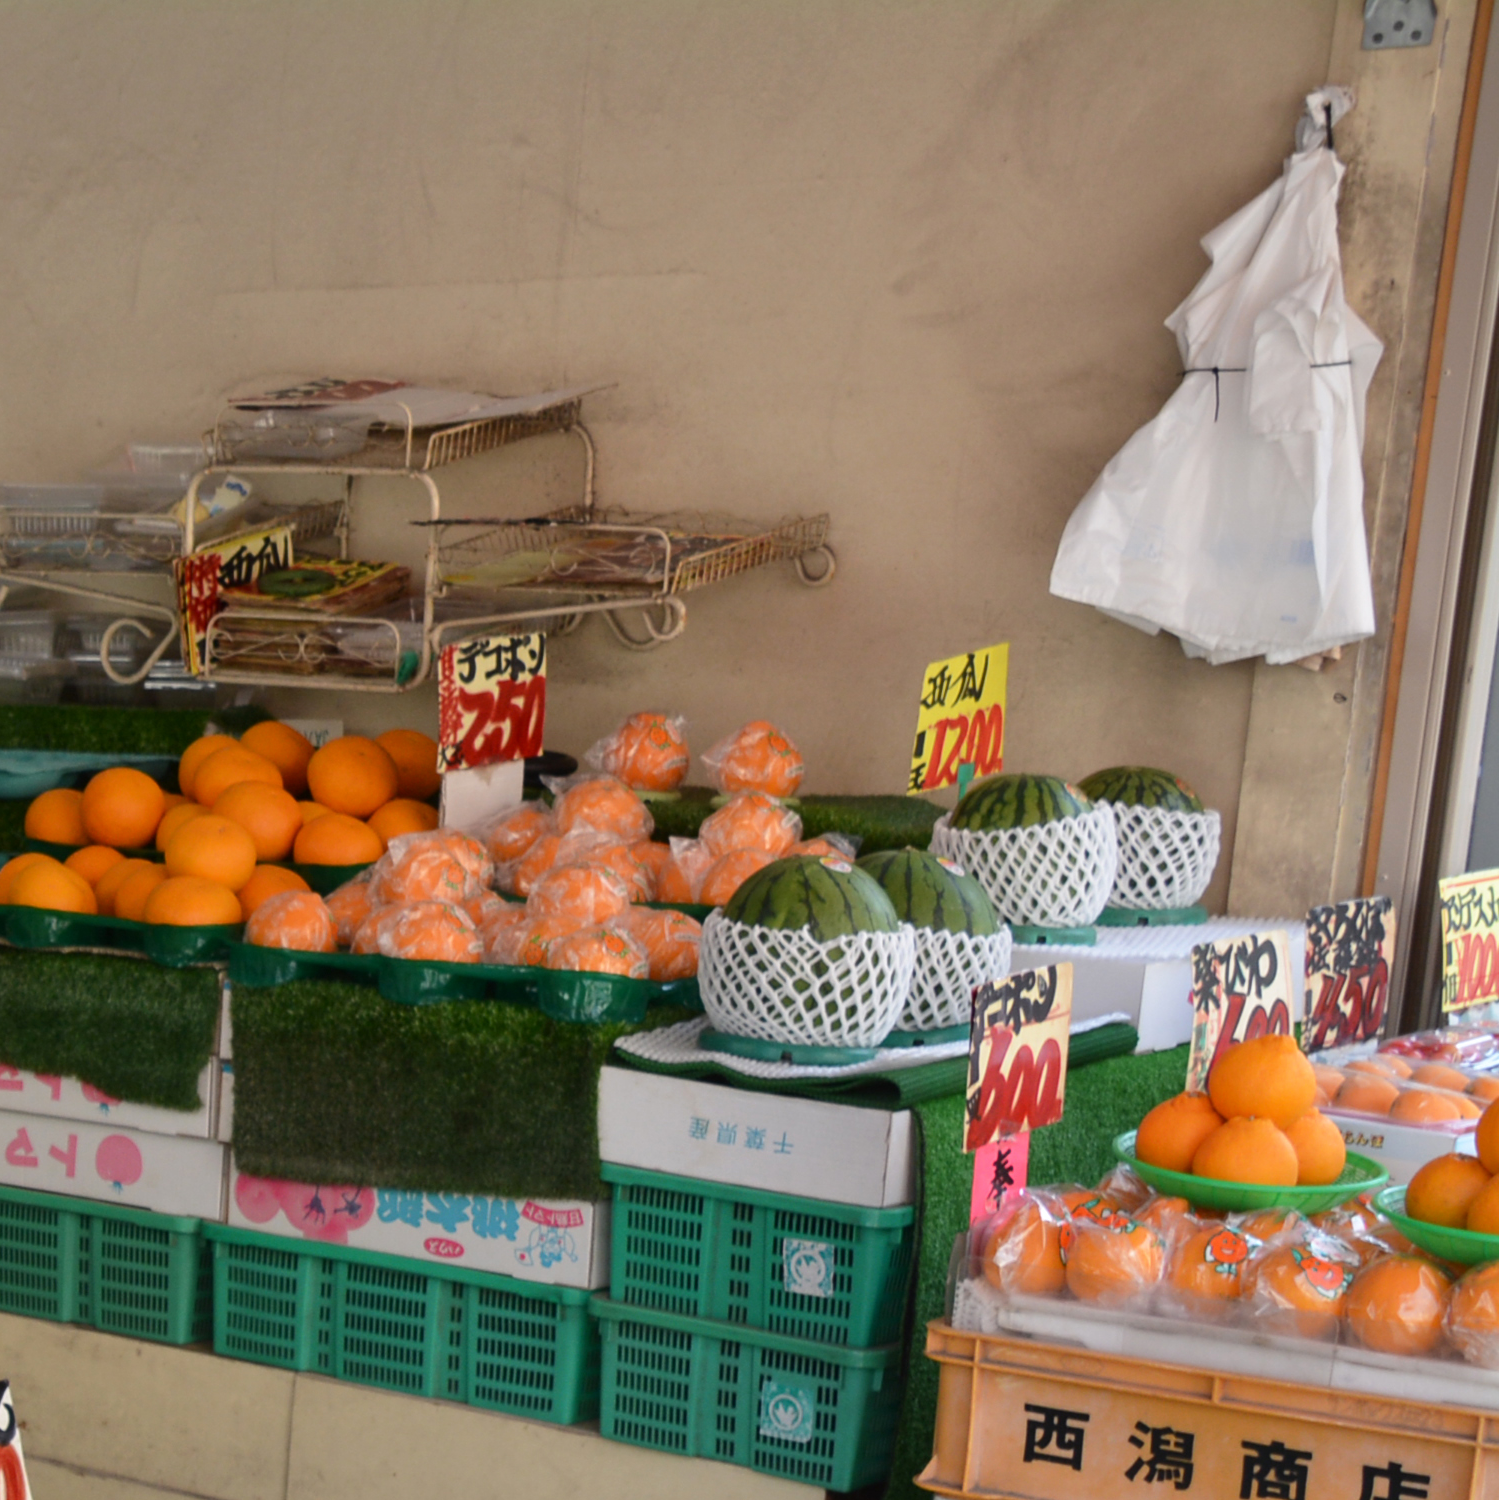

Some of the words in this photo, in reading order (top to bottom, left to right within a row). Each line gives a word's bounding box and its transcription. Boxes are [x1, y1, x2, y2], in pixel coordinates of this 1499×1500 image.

[457, 633, 546, 683] デコポン
[459, 676, 546, 768] 250
[922, 703, 1002, 790] 1200
[1216, 934, 1279, 1000] びわ
[1311, 956, 1390, 1050] 450
[967, 1024, 1063, 1154] 600
[688, 1116, 795, 1155] 千葉県産
